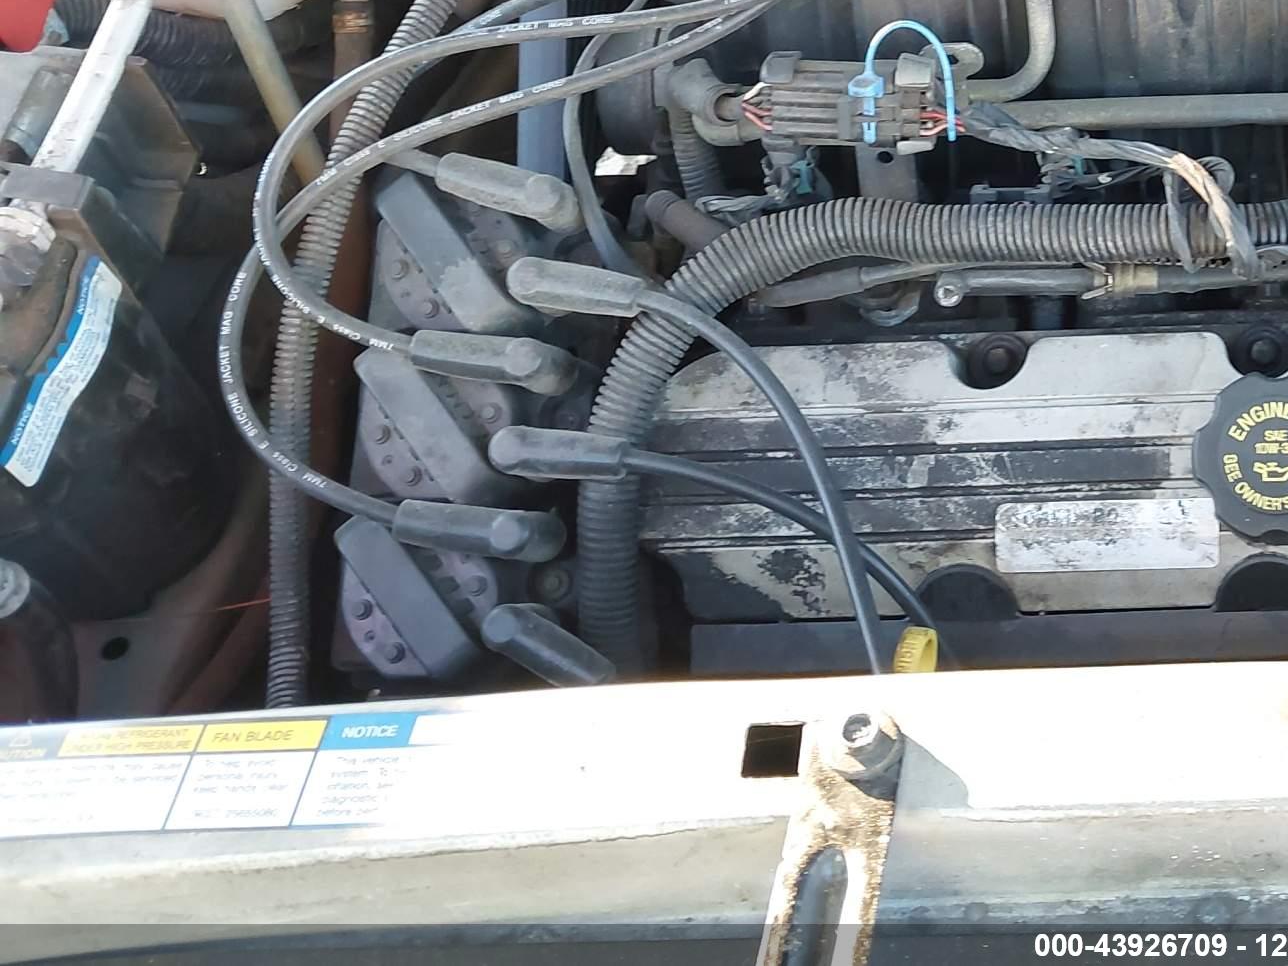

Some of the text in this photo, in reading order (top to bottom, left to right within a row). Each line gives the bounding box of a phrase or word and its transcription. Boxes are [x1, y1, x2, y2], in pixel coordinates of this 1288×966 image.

[219, 345, 234, 384] JACKET
[211, 729, 295, 743] FAN BLADE
[341, 724, 400, 739] NOTICE
